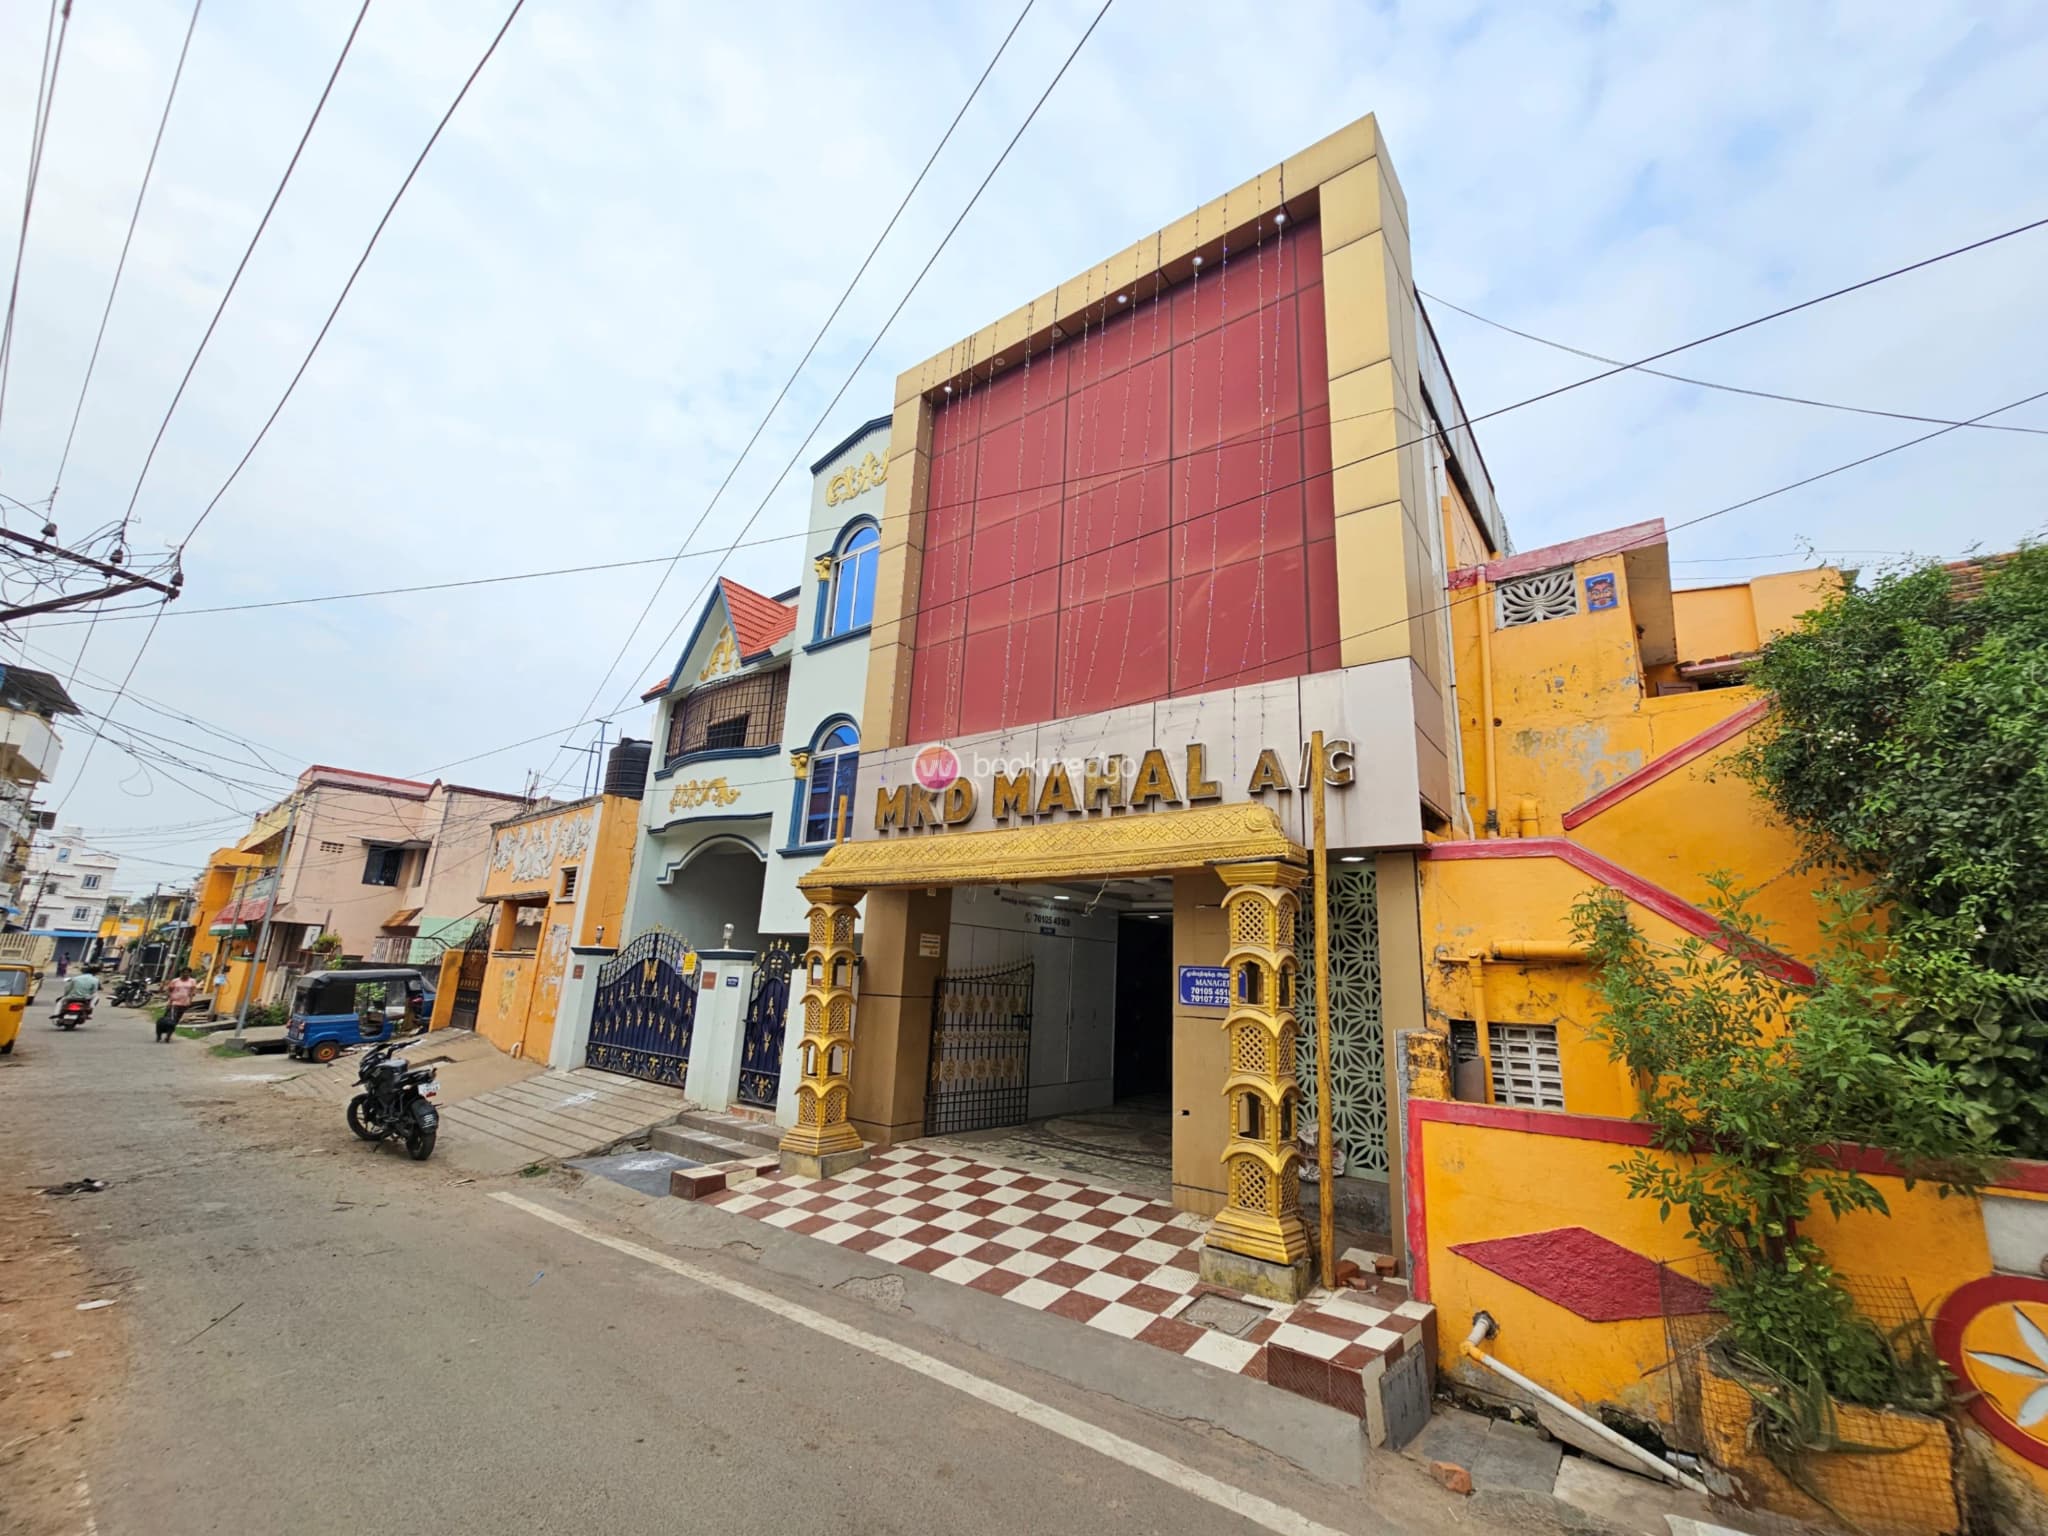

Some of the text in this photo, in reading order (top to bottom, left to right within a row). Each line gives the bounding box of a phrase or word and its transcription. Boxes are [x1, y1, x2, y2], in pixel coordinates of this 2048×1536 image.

[874, 776, 978, 831] MKD
[993, 743, 1223, 820] MAHAL
[1190, 987, 1213, 995] 70105
[1190, 995, 1213, 1003] 70107
